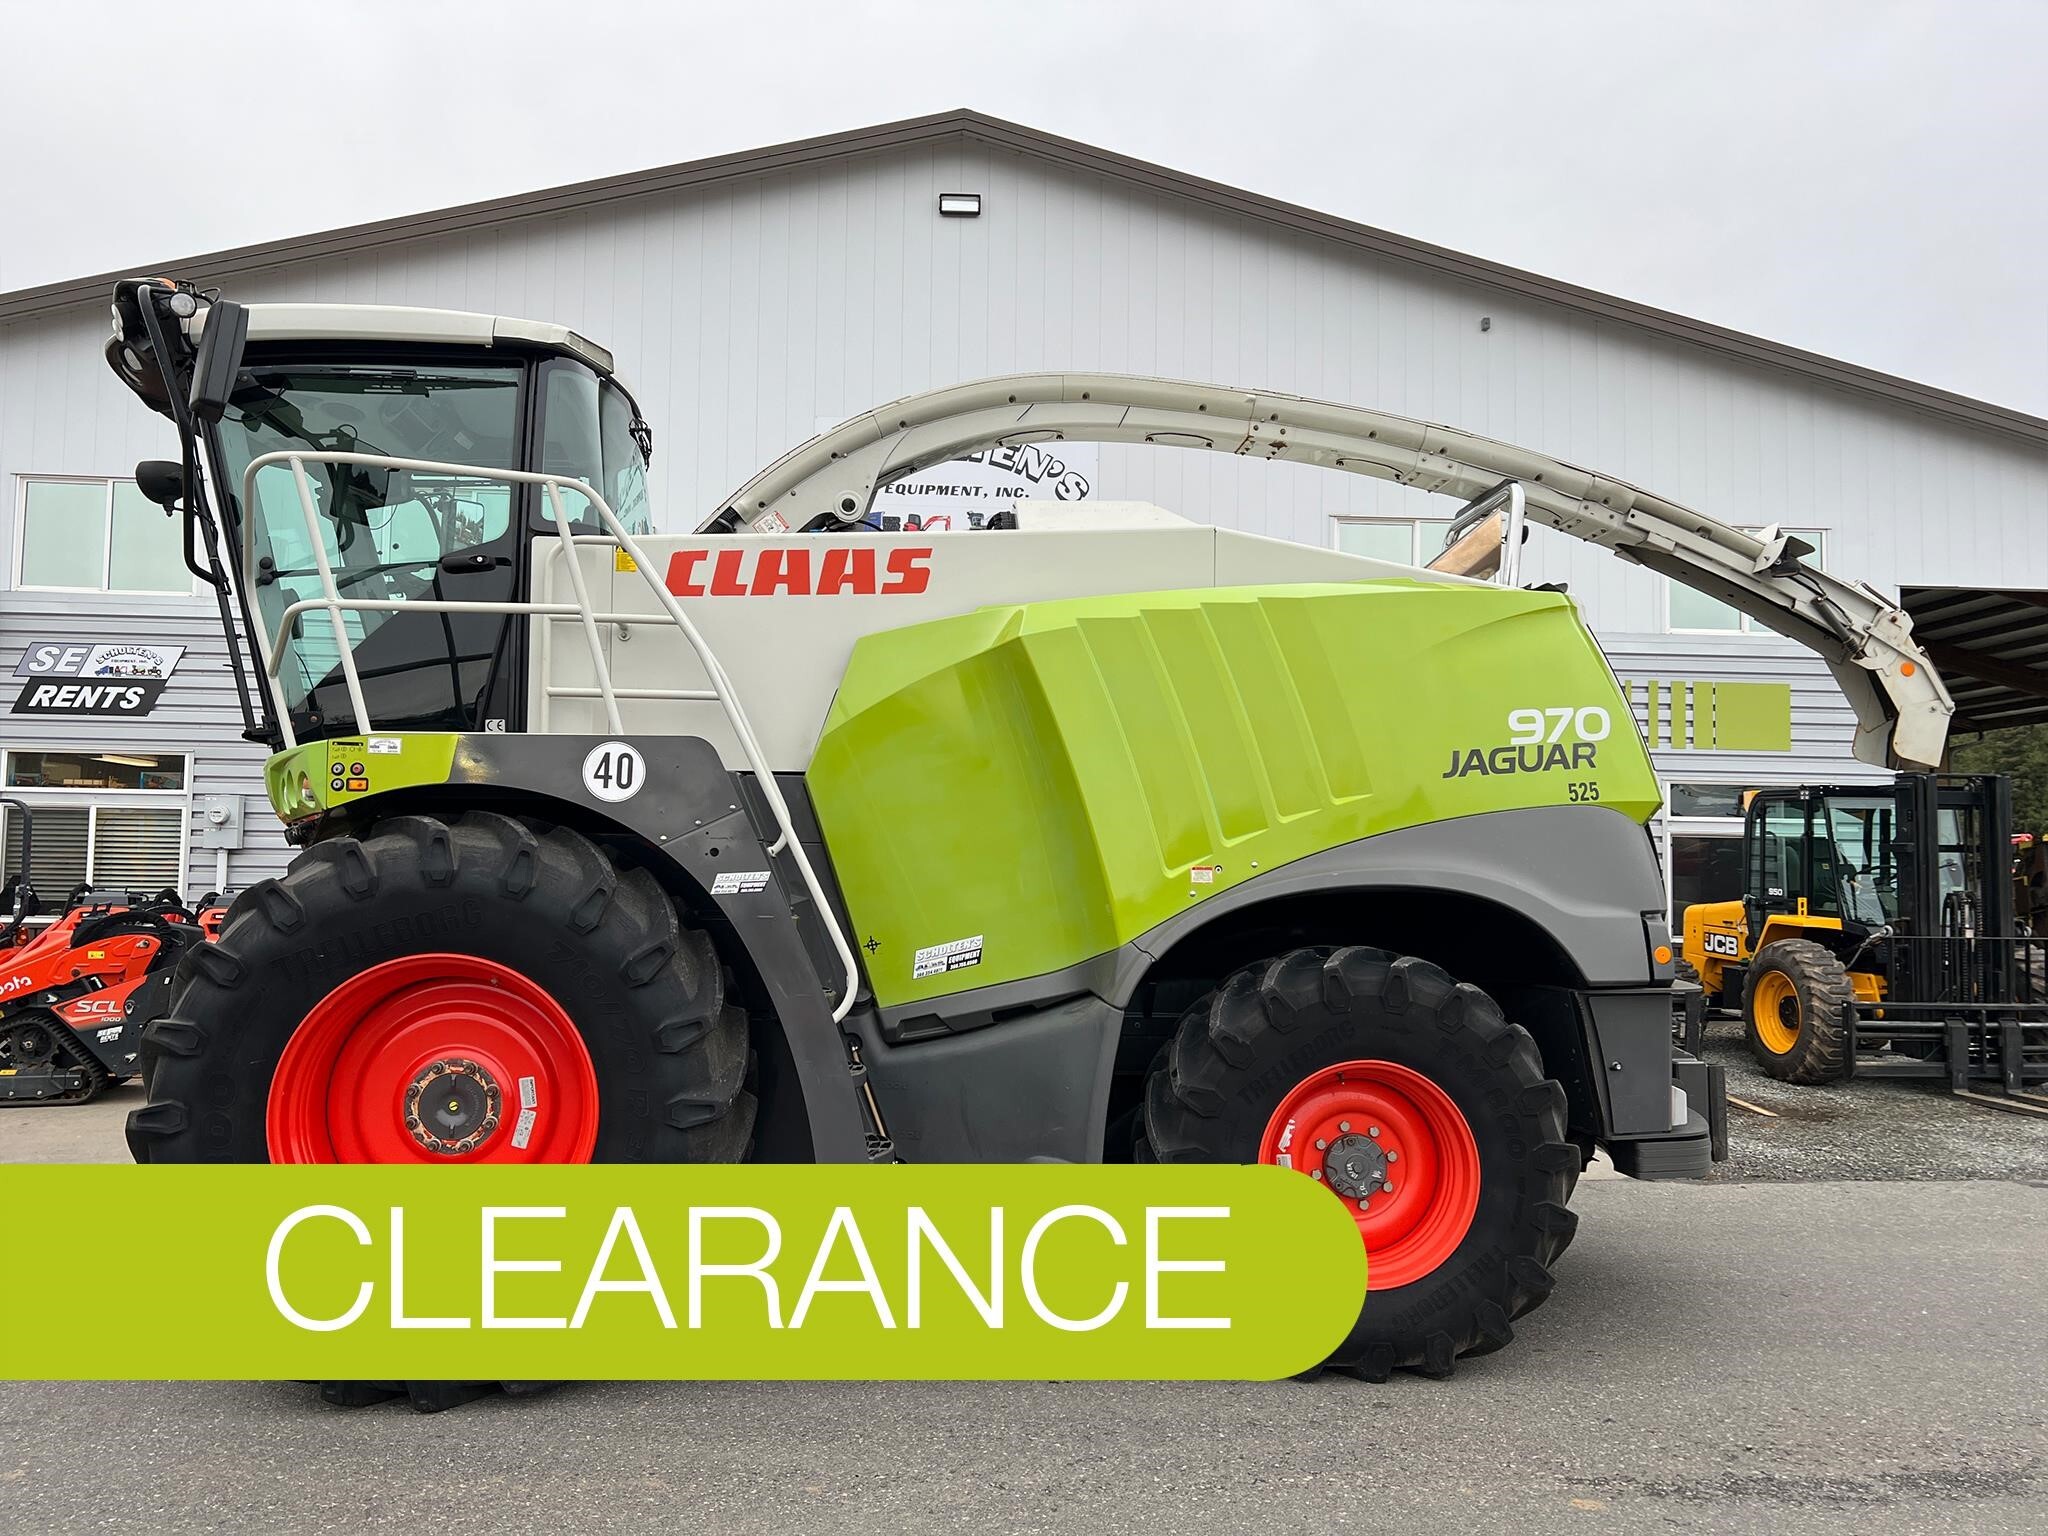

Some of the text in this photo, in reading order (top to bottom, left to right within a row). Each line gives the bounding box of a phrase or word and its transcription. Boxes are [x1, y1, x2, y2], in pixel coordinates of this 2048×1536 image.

[884, 483, 1030, 499] EQUIPMENT, INC.
[665, 548, 933, 597] CLAAS
[28, 646, 89, 673] SE
[96, 646, 164, 665] SCHOLTEN'S
[28, 684, 145, 709] RENTS
[1508, 706, 1611, 745] 970
[593, 752, 634, 789] 40
[1442, 743, 1597, 778] JAGUAR
[1568, 781, 1600, 802] 525
[916, 938, 982, 961] SCHOLTEN'S
[1704, 933, 1738, 955] JCB
[948, 949, 981, 964] EQUIPMENT
[74, 1000, 122, 1013] SCL
